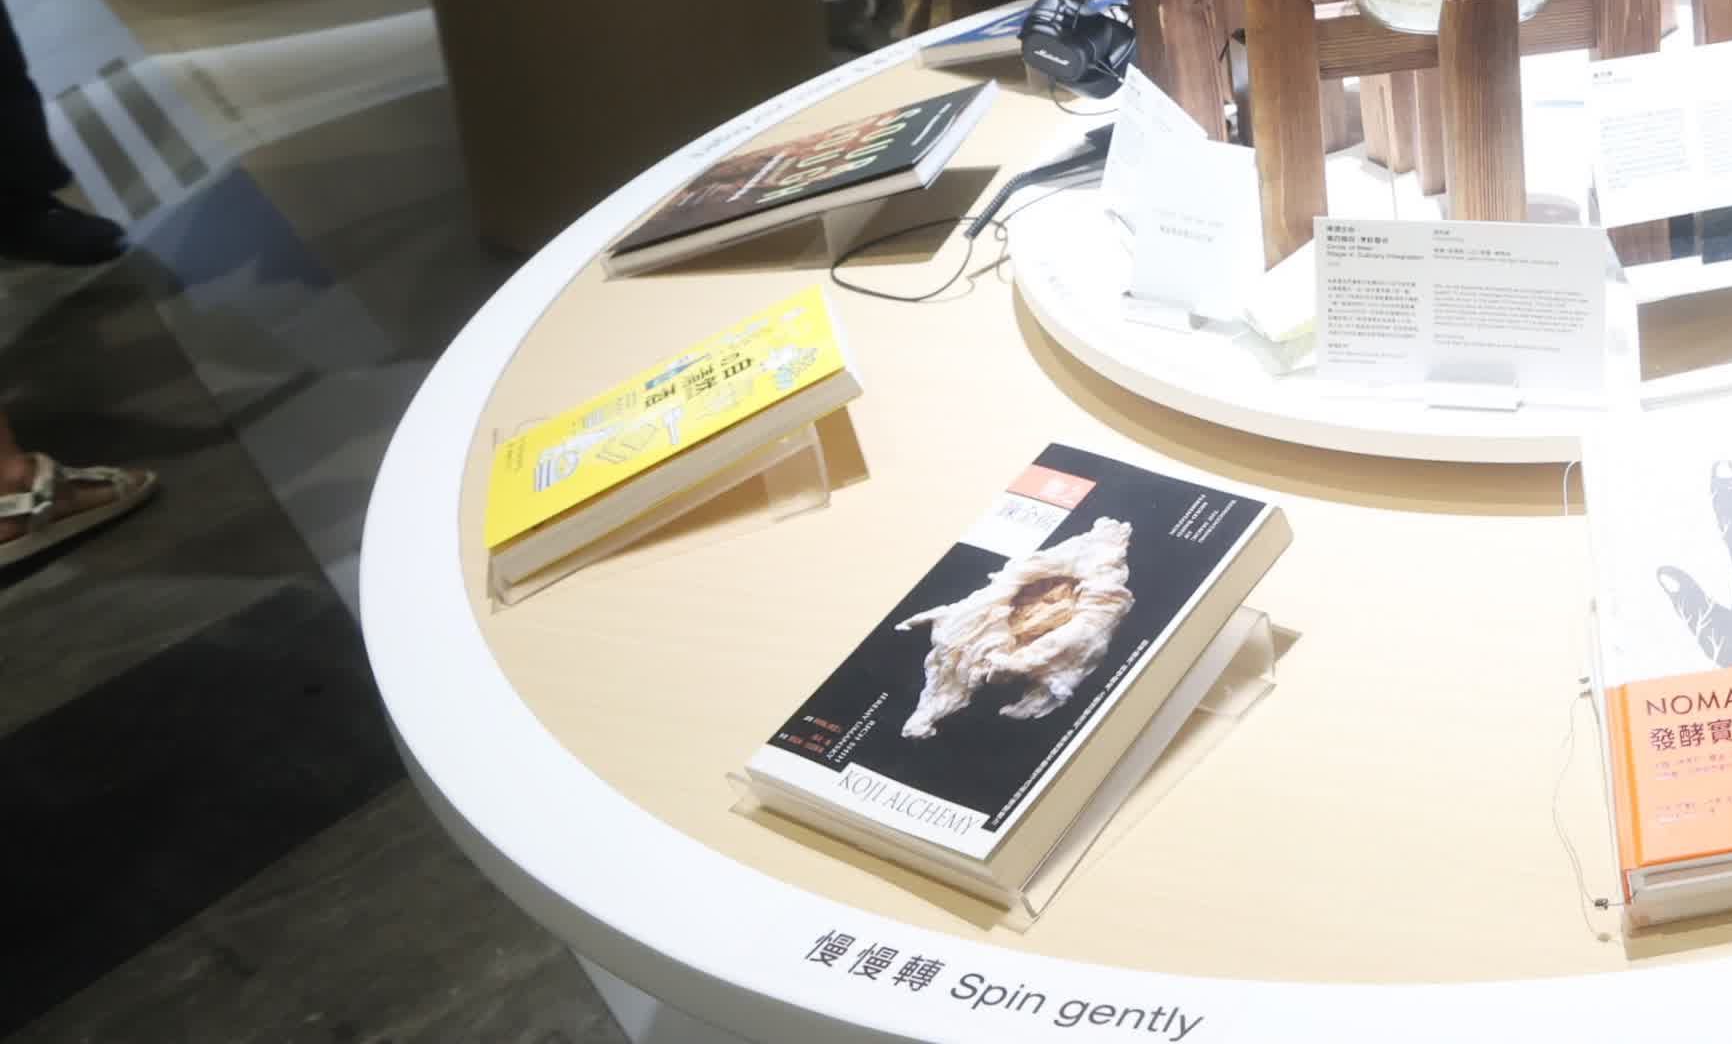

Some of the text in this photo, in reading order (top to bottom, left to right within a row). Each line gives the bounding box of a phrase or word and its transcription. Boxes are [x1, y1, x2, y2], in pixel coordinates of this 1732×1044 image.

[825, 720, 864, 761] UMANSKY
[835, 719, 877, 764] RICH SHIH
[838, 769, 980, 836] KOJI ALCHEMY
[804, 928, 1205, 1043] 慢慢轉 Spin gently
